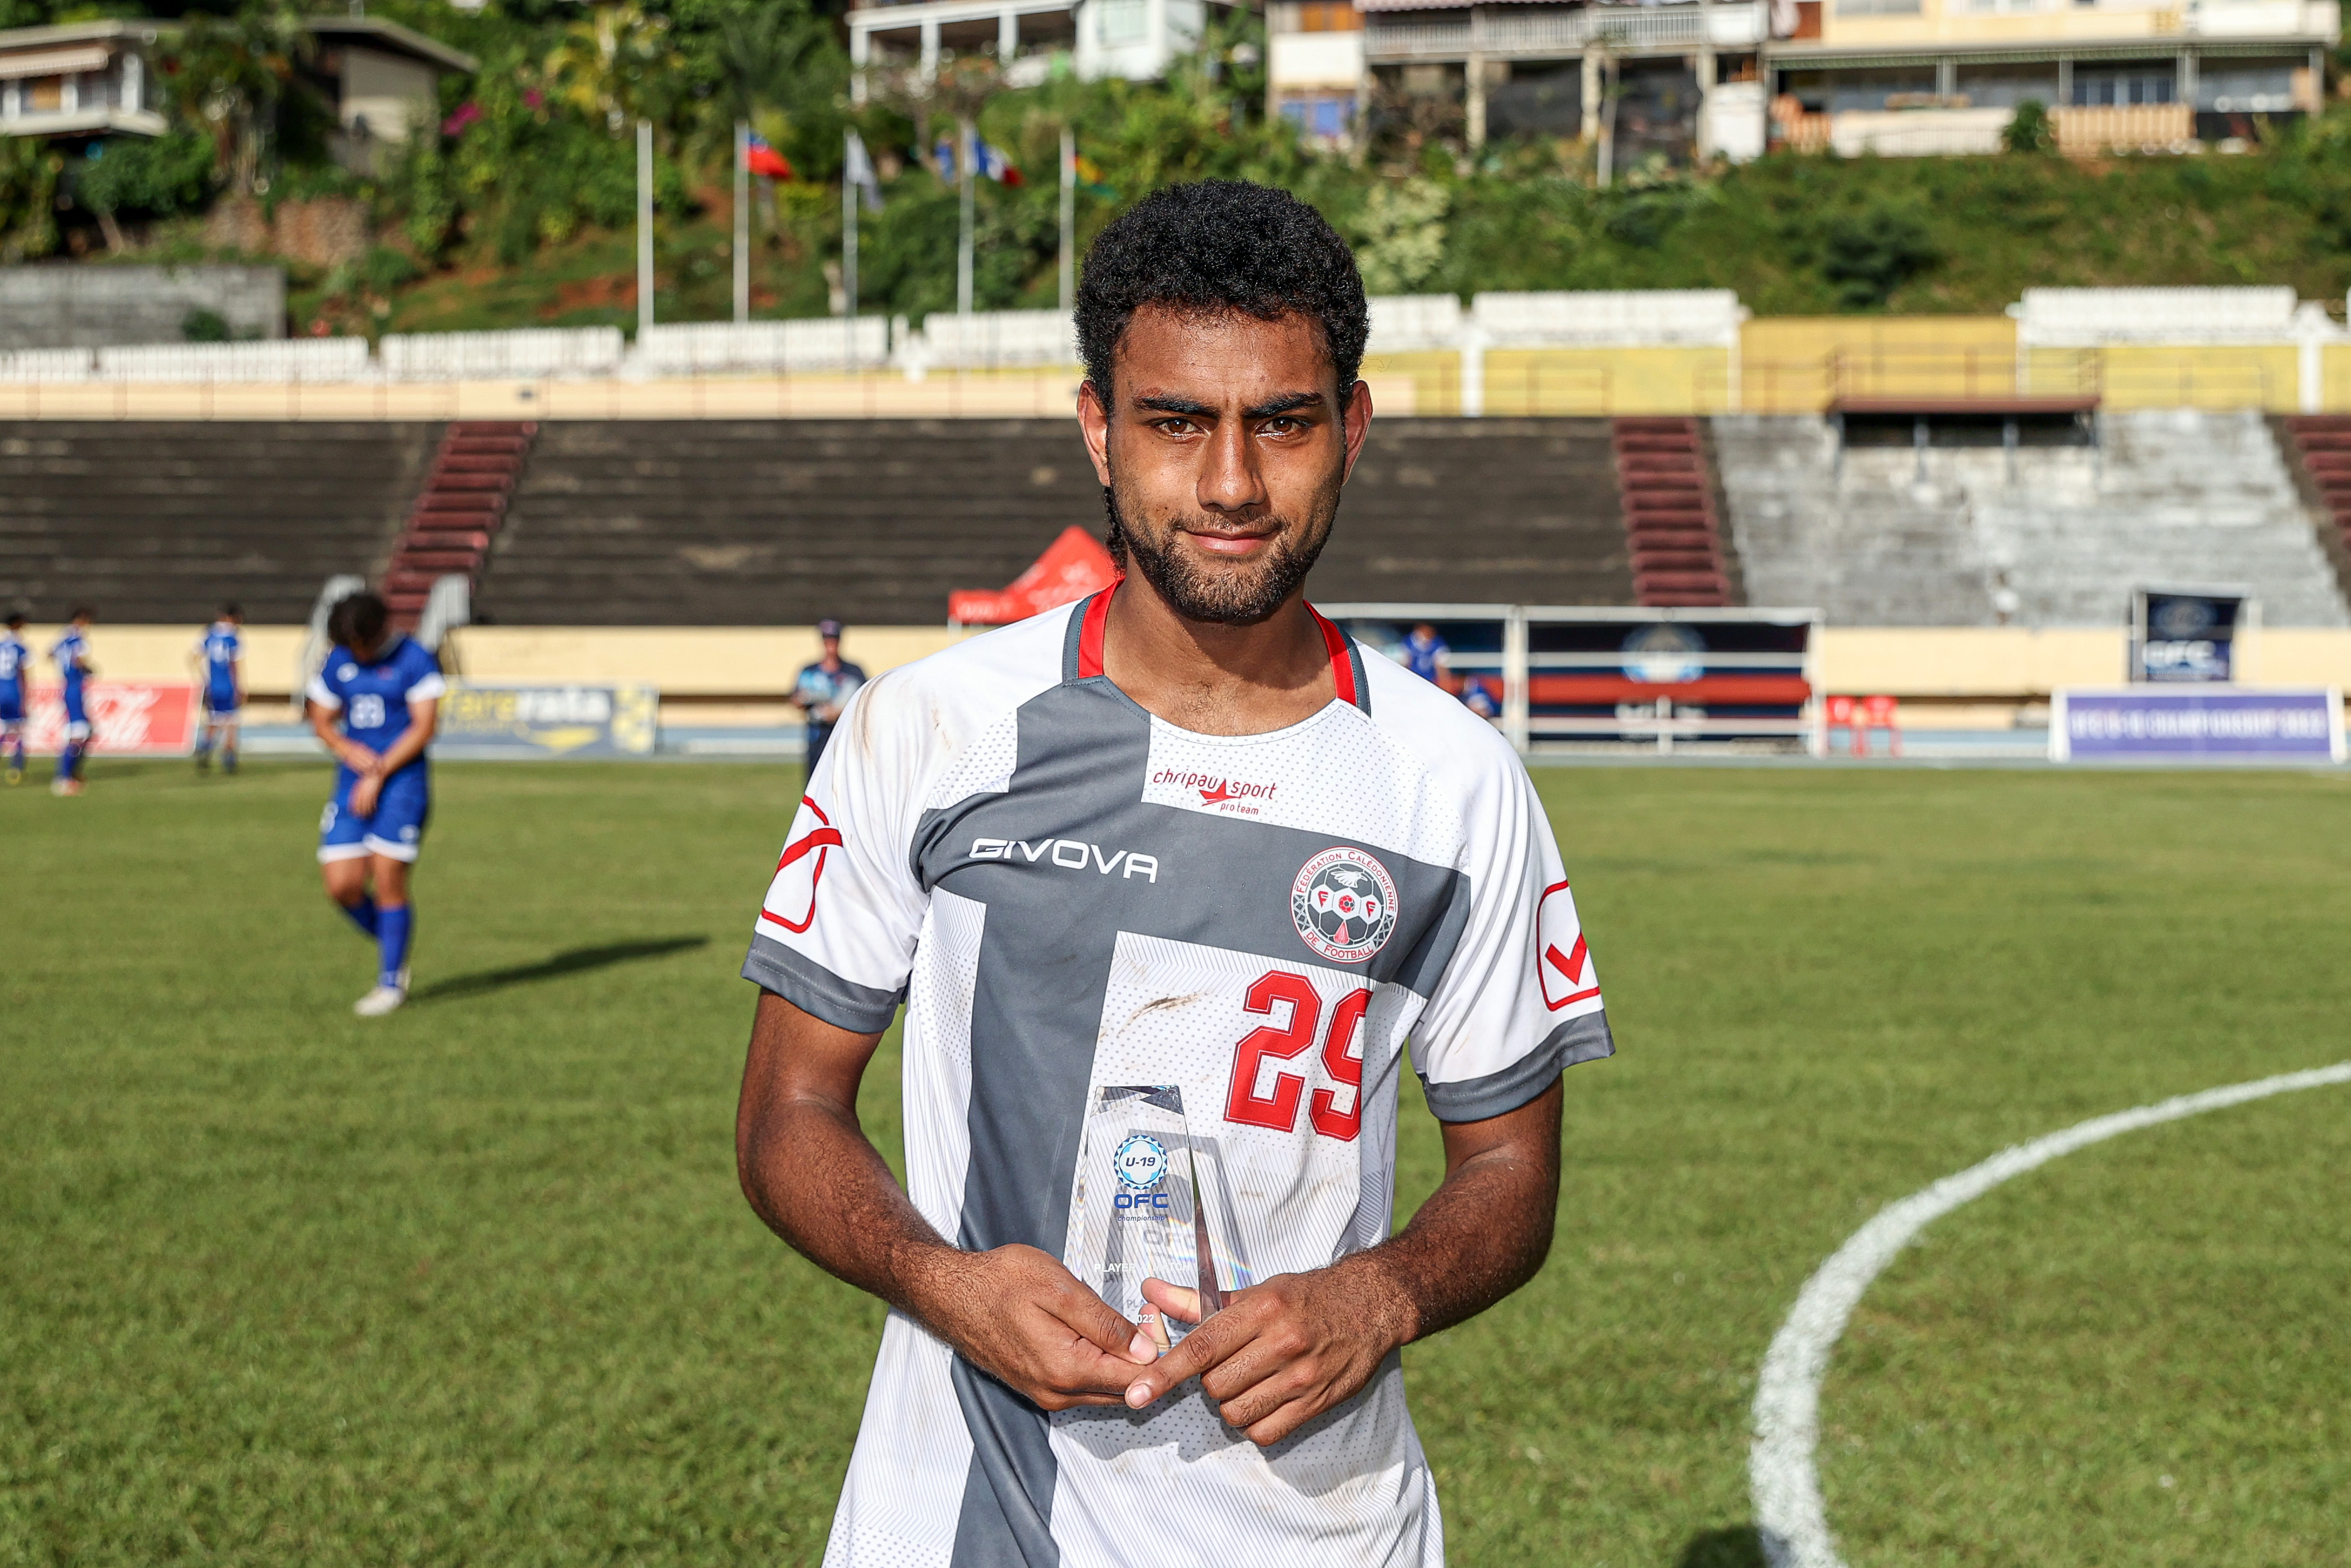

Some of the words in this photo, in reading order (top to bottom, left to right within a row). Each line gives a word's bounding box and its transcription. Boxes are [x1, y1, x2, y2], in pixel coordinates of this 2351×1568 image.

[1153, 768, 1218, 789] chripau
[1231, 782, 1277, 800] sport
[1220, 803, 1234, 812] pro
[1237, 803, 1259, 815] team
[969, 838, 1158, 883] GIVOVA
[1297, 853, 1342, 894] FÉDÉRATION
[1306, 931, 1320, 946] DE
[1324, 945, 1374, 959] FOOTBALL
[1223, 970, 1373, 1142] 29
[1126, 1157, 1156, 1167] U-19
[1114, 1193, 1168, 1208] OFC
[1094, 1263, 1135, 1272] PLAYER
[1134, 1314, 1155, 1324] 022
